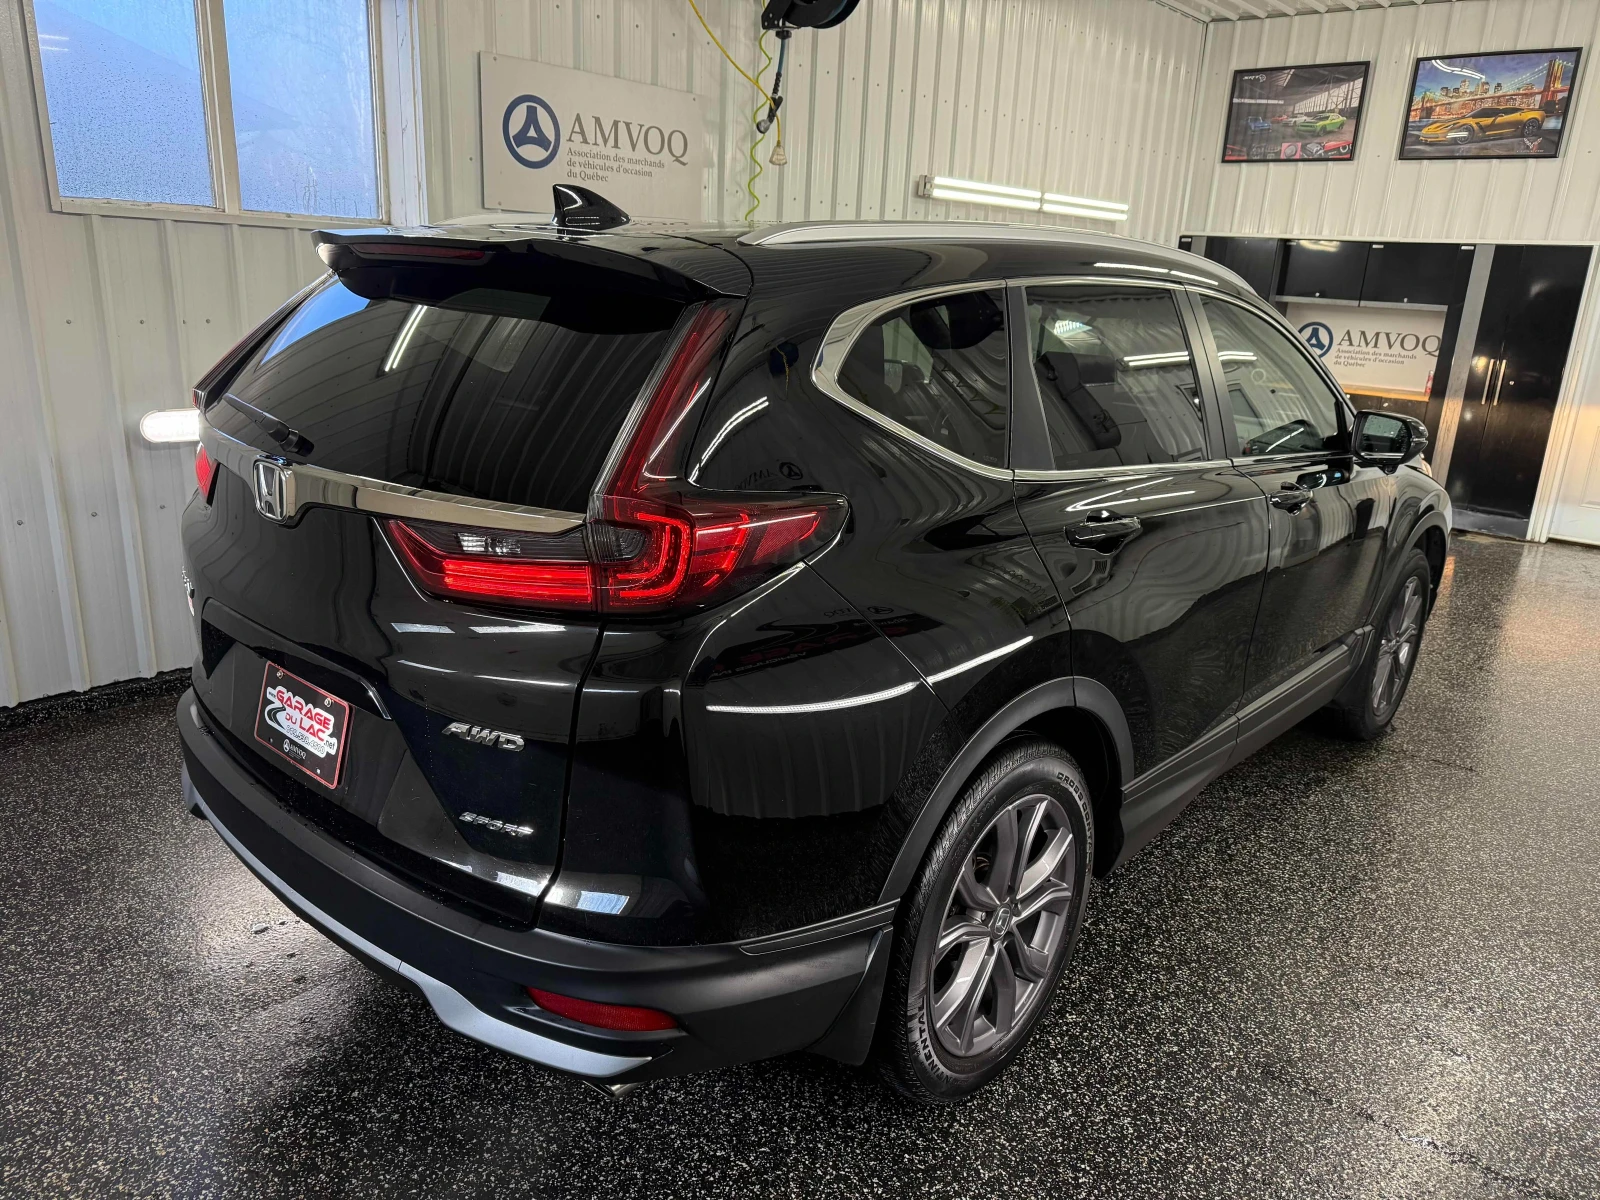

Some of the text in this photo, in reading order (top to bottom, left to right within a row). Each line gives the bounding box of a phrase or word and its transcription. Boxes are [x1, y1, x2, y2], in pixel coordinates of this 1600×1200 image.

[566, 113, 689, 166] AMVOQ
[567, 147, 665, 169] Association des marchands
[567, 158, 653, 178] de véhicules d'occasion
[567, 169, 609, 182] du Québec
[1336, 348, 1370, 356] Association
[1383, 352, 1417, 360] marchands
[1337, 329, 1442, 357] AMVOQ
[1373, 356, 1405, 365] d'occasion
[276, 690, 332, 731] GARAGE
[285, 712, 298, 725] DU
[299, 717, 326, 742] LAC
[442, 722, 525, 752] AWD
[459, 812, 534, 837] SPORT
